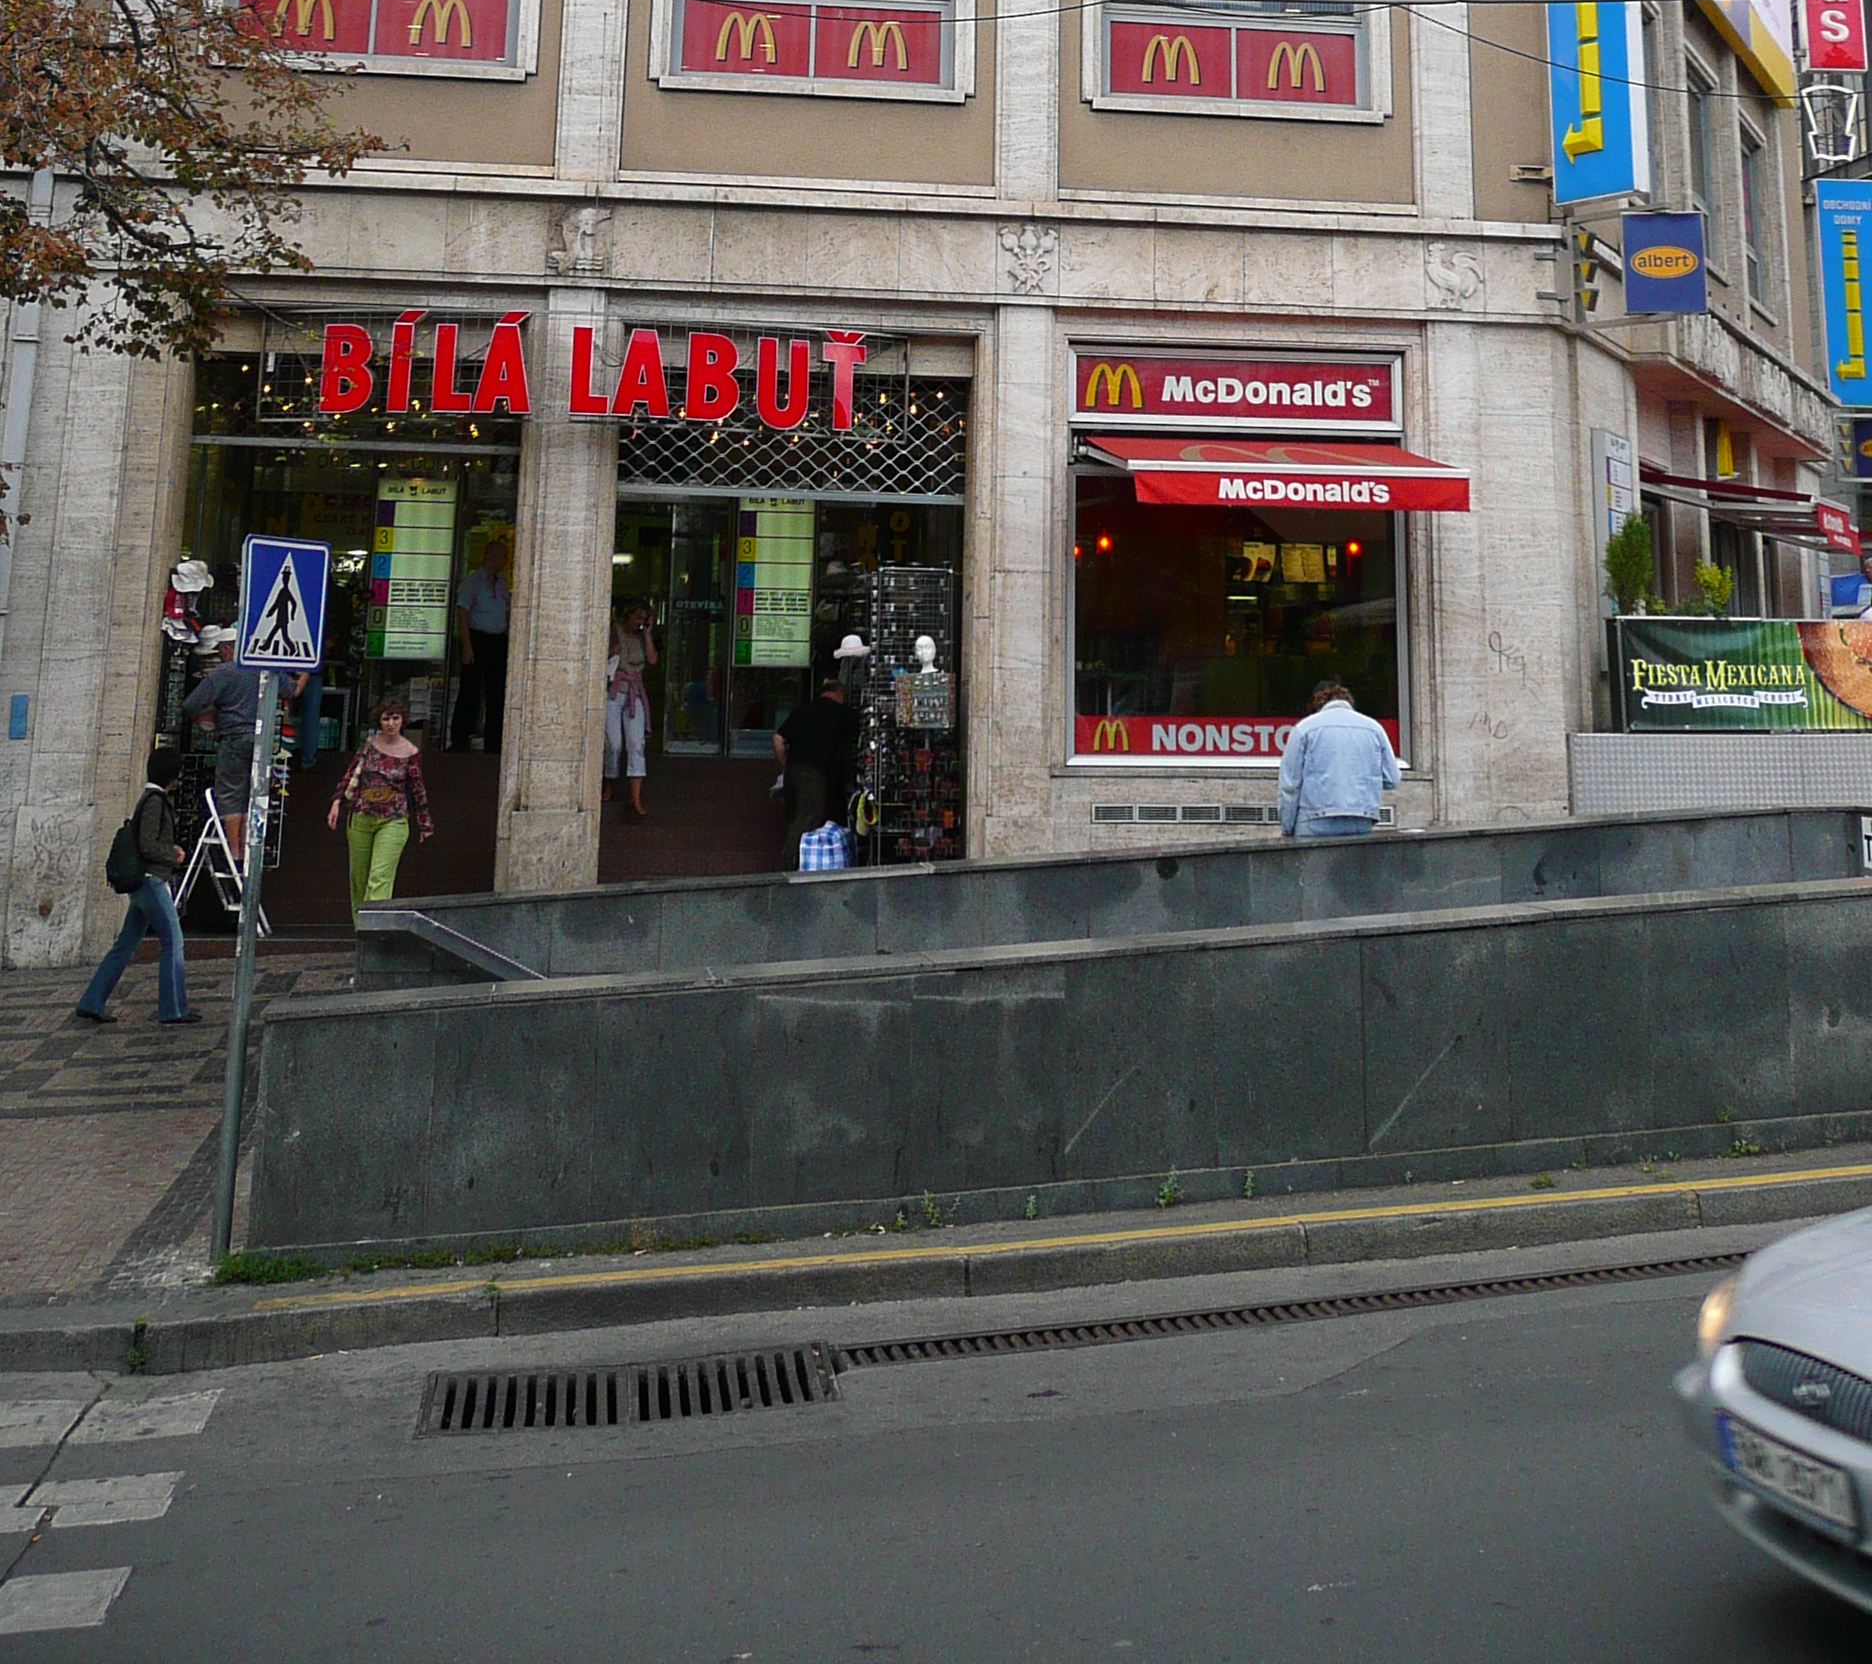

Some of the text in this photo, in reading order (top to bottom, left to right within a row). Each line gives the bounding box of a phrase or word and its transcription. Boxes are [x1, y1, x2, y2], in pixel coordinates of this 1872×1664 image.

[1636, 251, 1690, 270] albert
[319, 310, 867, 431] BÍLÁ LABUŤ
[1218, 478, 1390, 503] McDonald's
[379, 529, 389, 545] 3
[743, 539, 752, 555] 3
[377, 555, 387, 571] 2
[373, 608, 383, 624] 0
[739, 617, 750, 633] 0
[1630, 659, 1806, 692] FIESTA MEXICANA
[1152, 724, 1300, 752] NONSTO
